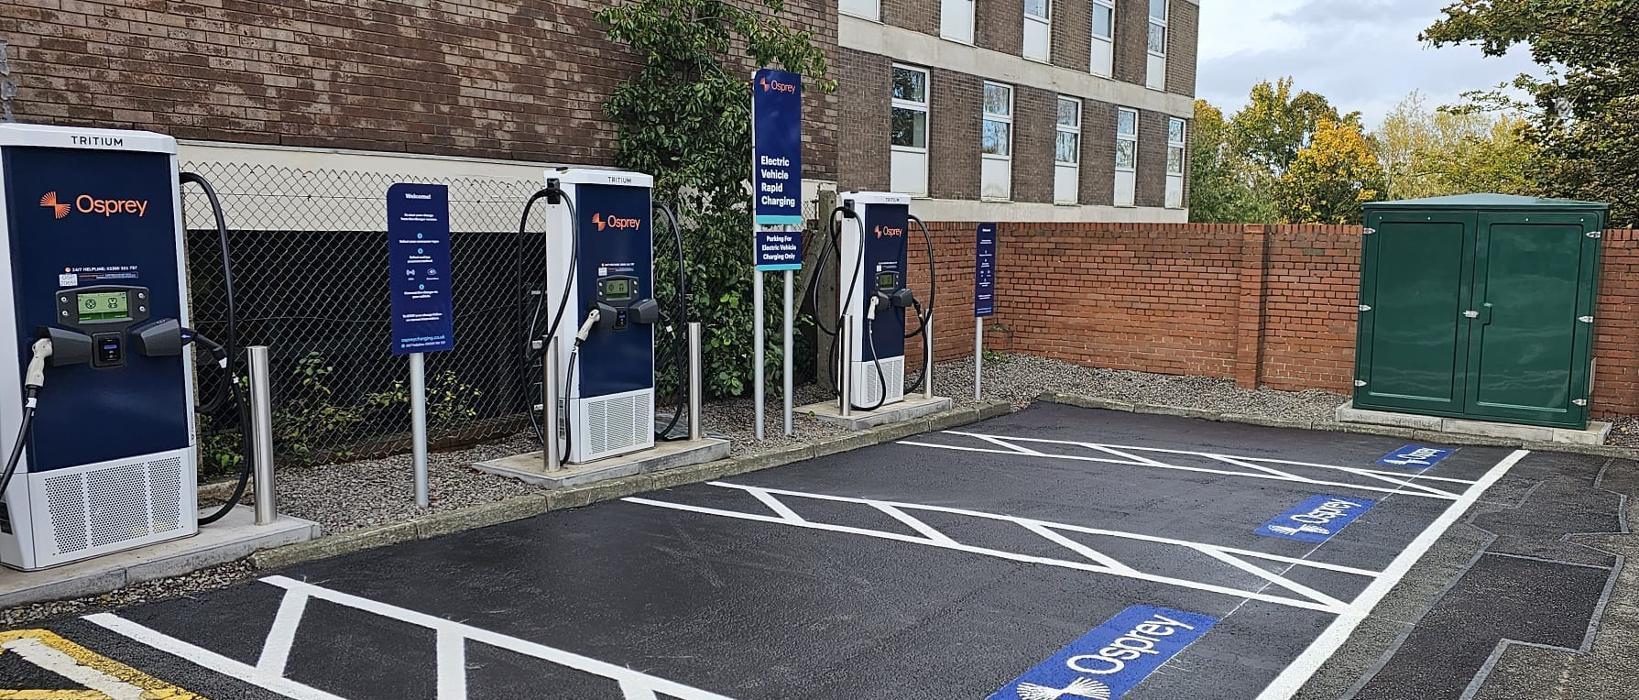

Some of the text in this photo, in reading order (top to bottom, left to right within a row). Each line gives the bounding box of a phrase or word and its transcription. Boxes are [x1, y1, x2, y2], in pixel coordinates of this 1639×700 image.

[770, 80, 796, 94] Osprey
[70, 135, 124, 147] TRITIUM
[760, 155, 790, 166] Electric
[608, 176, 632, 184] TRITIUM
[761, 169, 789, 180] Vehicle
[761, 182, 783, 193] Rapid
[76, 194, 148, 217] Osprey
[761, 195, 795, 208] Charging
[607, 215, 641, 230] Osprey
[883, 226, 903, 236] Osprey
[766, 235, 783, 243] Parking
[761, 243, 797, 251] Electric Vehicle
[762, 252, 796, 260] Charging Only
[1397, 447, 1446, 460] Osprey
[1289, 498, 1362, 526] Osprey
[1065, 613, 1196, 676] Osprey
